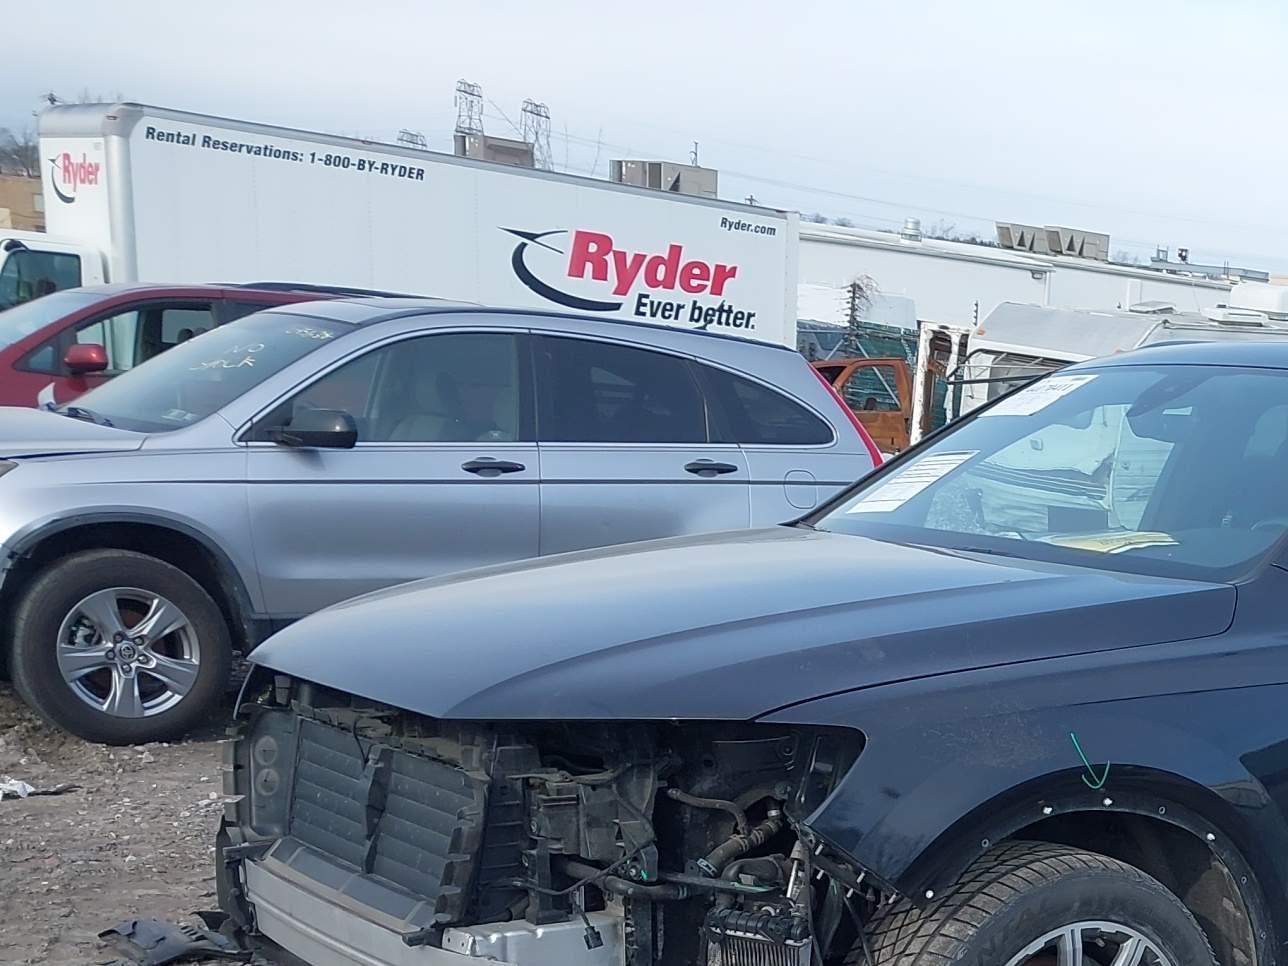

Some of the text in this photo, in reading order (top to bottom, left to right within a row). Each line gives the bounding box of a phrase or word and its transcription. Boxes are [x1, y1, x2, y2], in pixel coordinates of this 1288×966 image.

[62, 152, 100, 193] Ryder
[145, 126, 425, 181] Rental Reservations: 1-800-BY-RYDER
[720, 217, 777, 236] Ryder.com
[567, 230, 738, 297] Ryder
[634, 293, 757, 330] Ever better.
